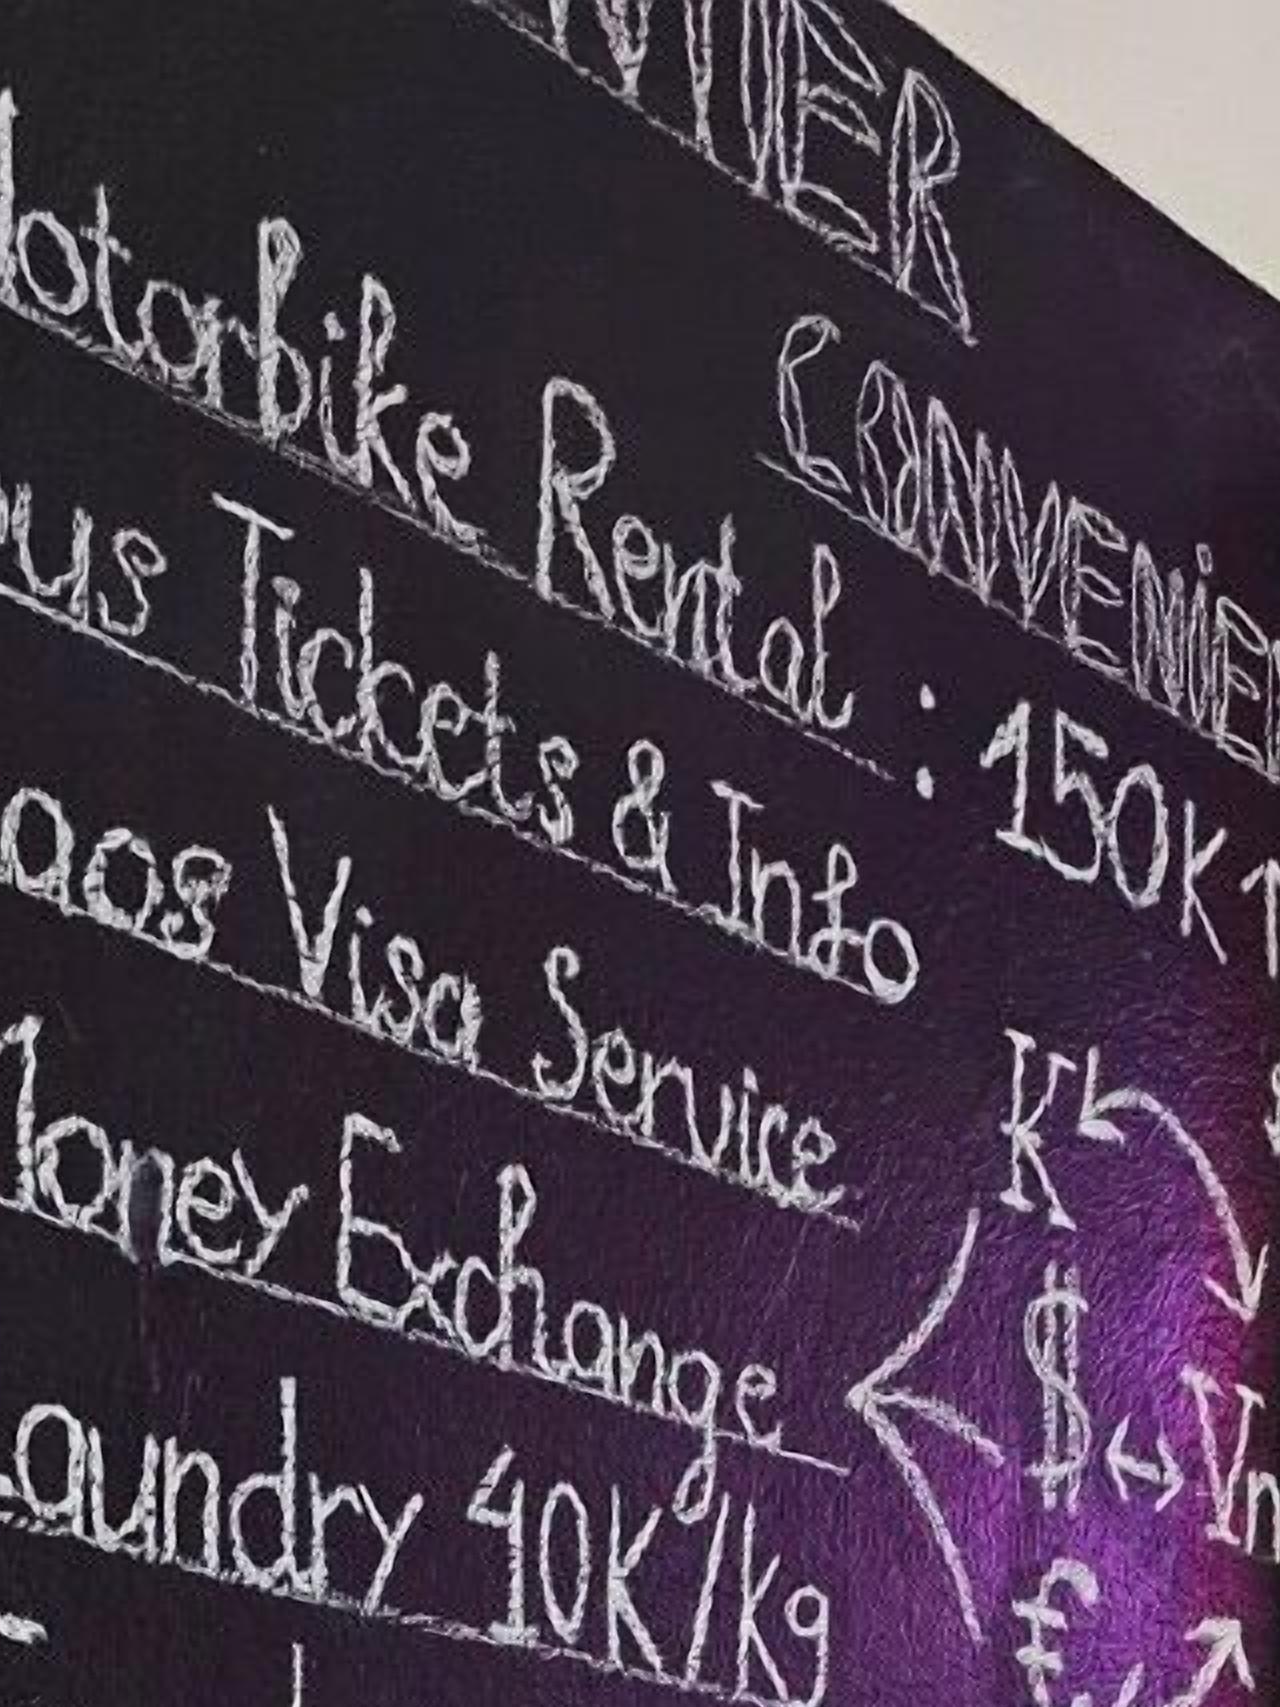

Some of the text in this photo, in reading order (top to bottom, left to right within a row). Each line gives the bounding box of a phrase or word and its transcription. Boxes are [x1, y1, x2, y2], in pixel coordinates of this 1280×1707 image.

[214, 494, 580, 848] Tickets
[608, 740, 672, 872] &
[712, 776, 920, 1004] Info
[532, 378, 856, 735] Rental
[978, 698, 1230, 966] 150K
[268, 806, 482, 1058] Visa
[530, 946, 844, 1206] Service
[1000, 1028, 1078, 1228] K
[334, 1116, 782, 1520] Exchange
[1024, 1264, 1092, 1506] $
